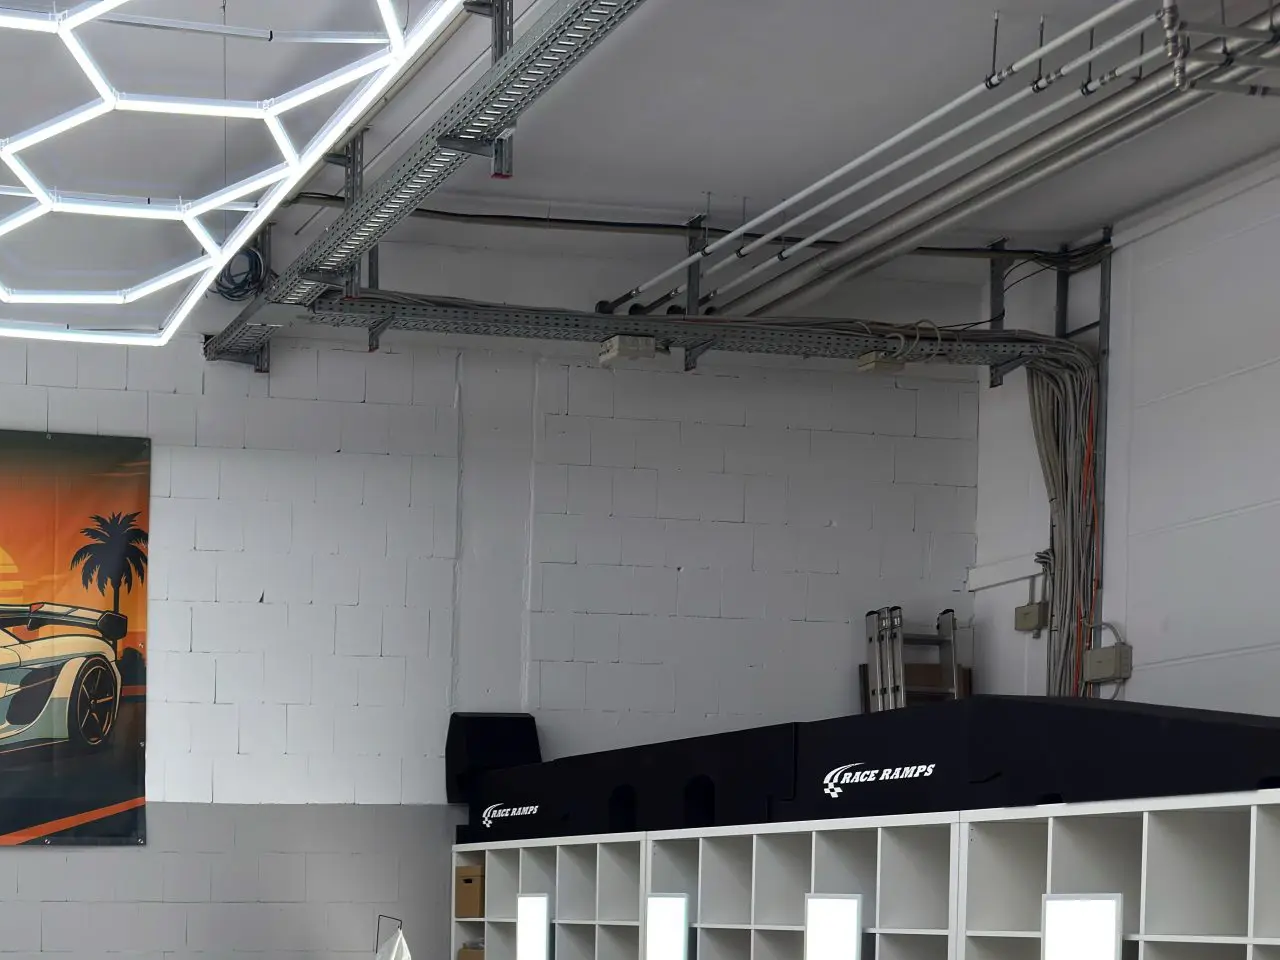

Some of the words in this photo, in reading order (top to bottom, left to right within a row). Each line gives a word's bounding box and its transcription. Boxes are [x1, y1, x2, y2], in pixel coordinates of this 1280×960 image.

[840, 769, 879, 784] RACE
[879, 763, 936, 780] RAMPS
[491, 808, 511, 818] RACE
[510, 805, 539, 817] RAMPS
